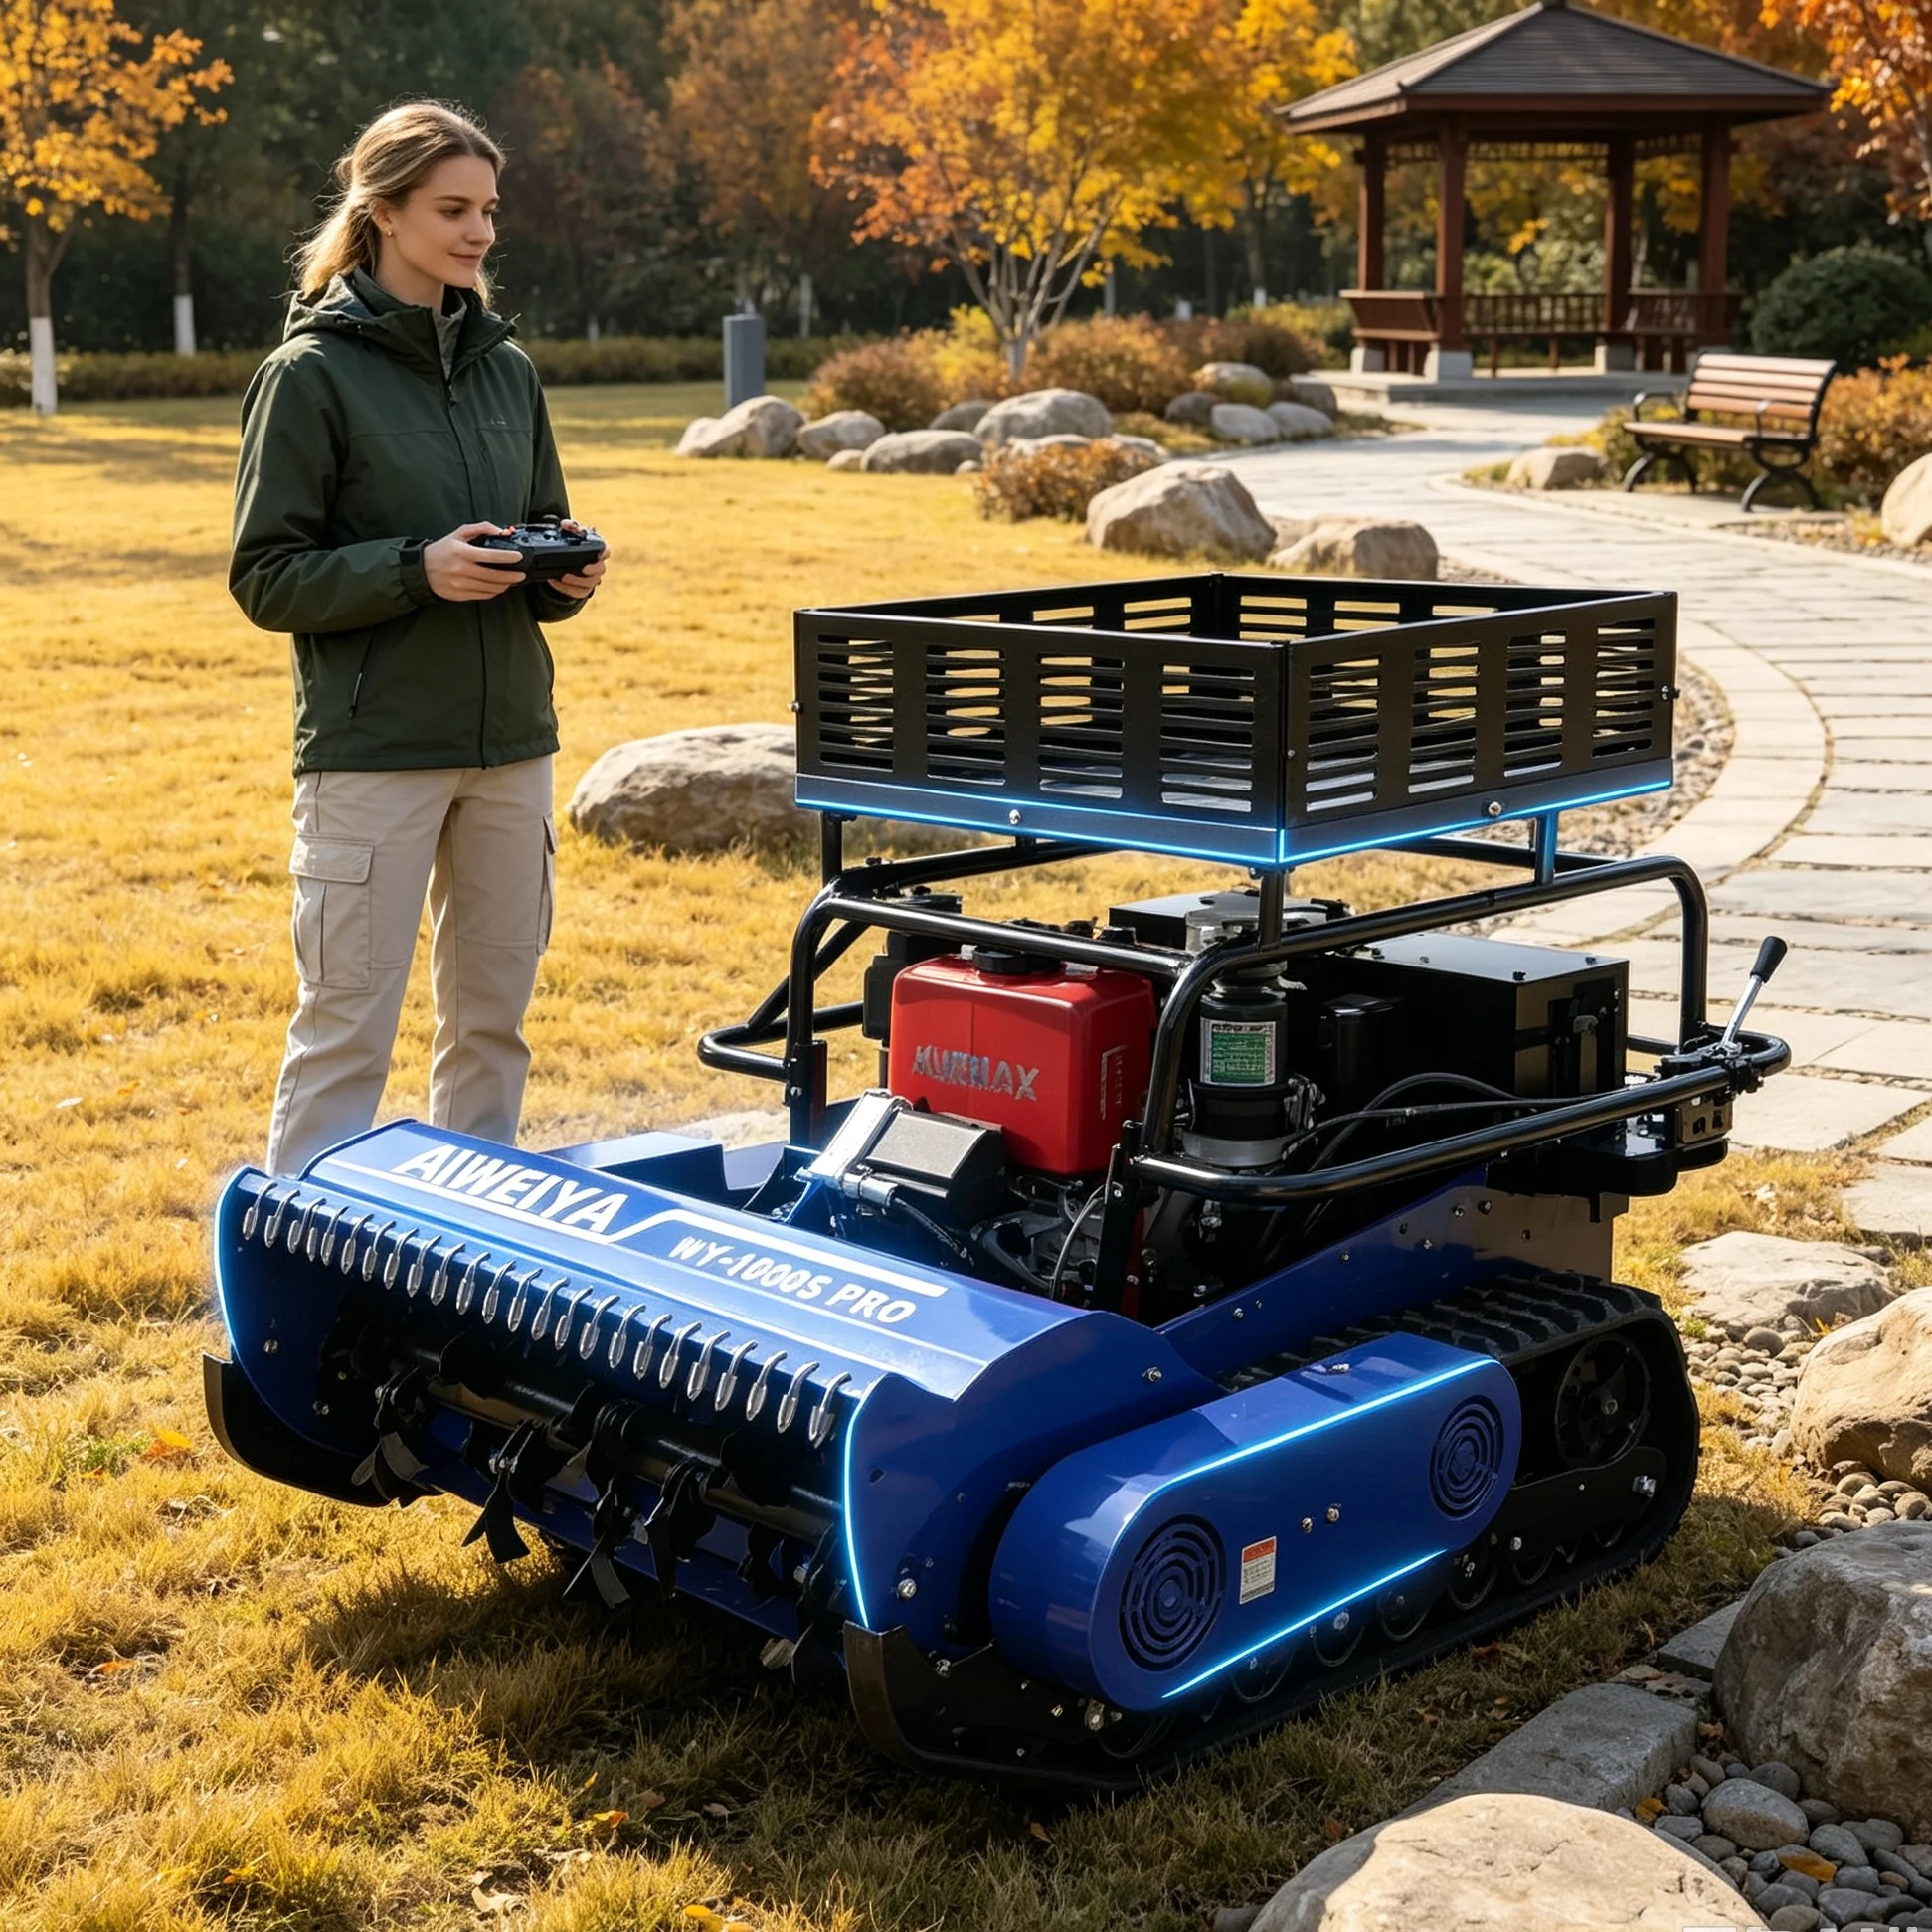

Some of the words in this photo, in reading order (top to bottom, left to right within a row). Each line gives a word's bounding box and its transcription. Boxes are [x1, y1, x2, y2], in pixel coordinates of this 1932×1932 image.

[392, 1144, 628, 1233] AIWEIYA
[669, 1236, 832, 1300] WY-1000S
[825, 1283, 917, 1323] PRO
